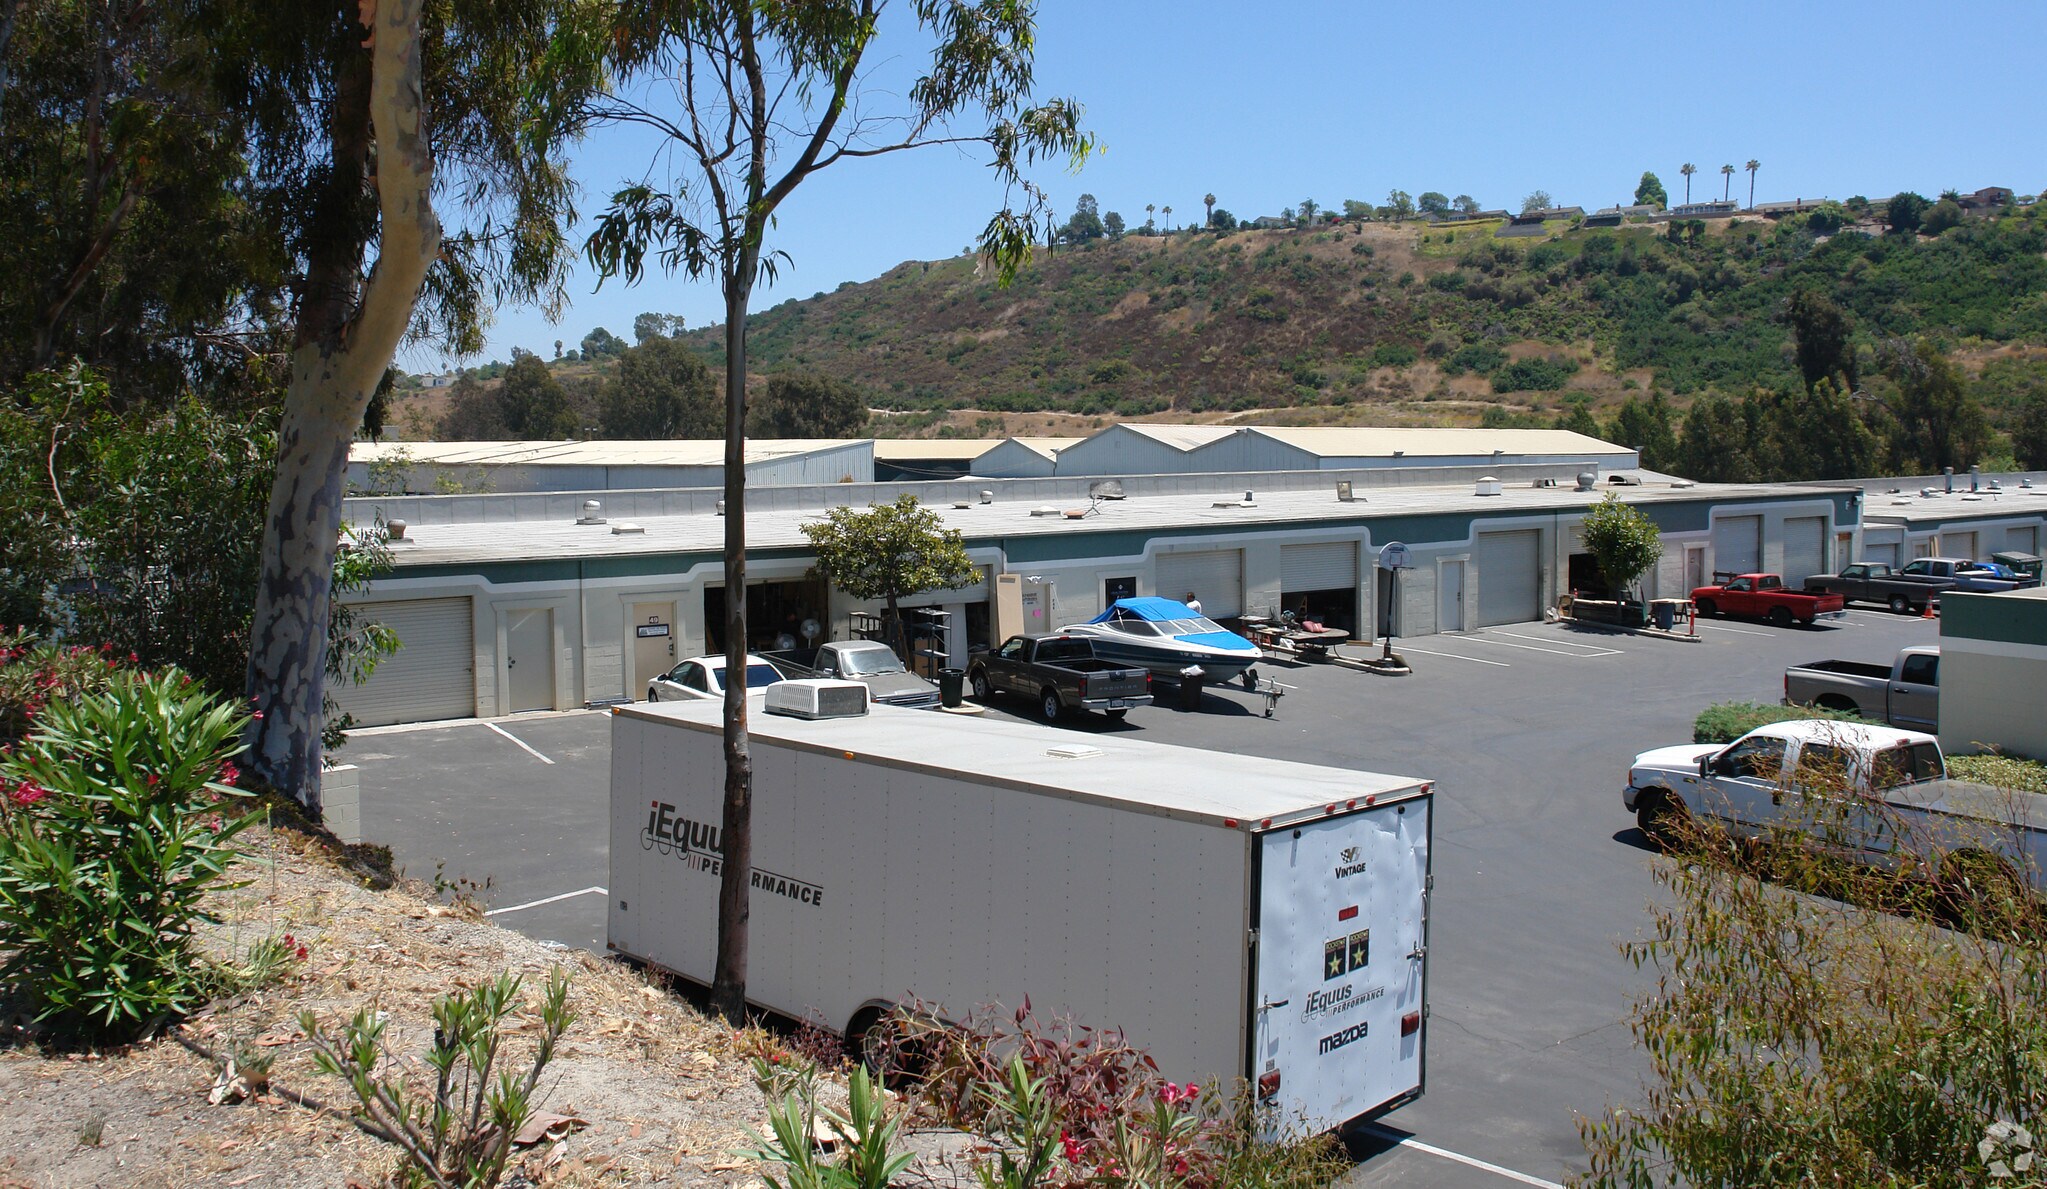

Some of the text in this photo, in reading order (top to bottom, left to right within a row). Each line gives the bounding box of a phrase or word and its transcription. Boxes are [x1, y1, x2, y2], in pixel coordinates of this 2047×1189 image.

[648, 801, 724, 853] iEquu
[702, 858, 823, 906] PERMANCE
[1306, 984, 1352, 1014] iEquus
[1333, 988, 1384, 1016] PERFORMANCE
